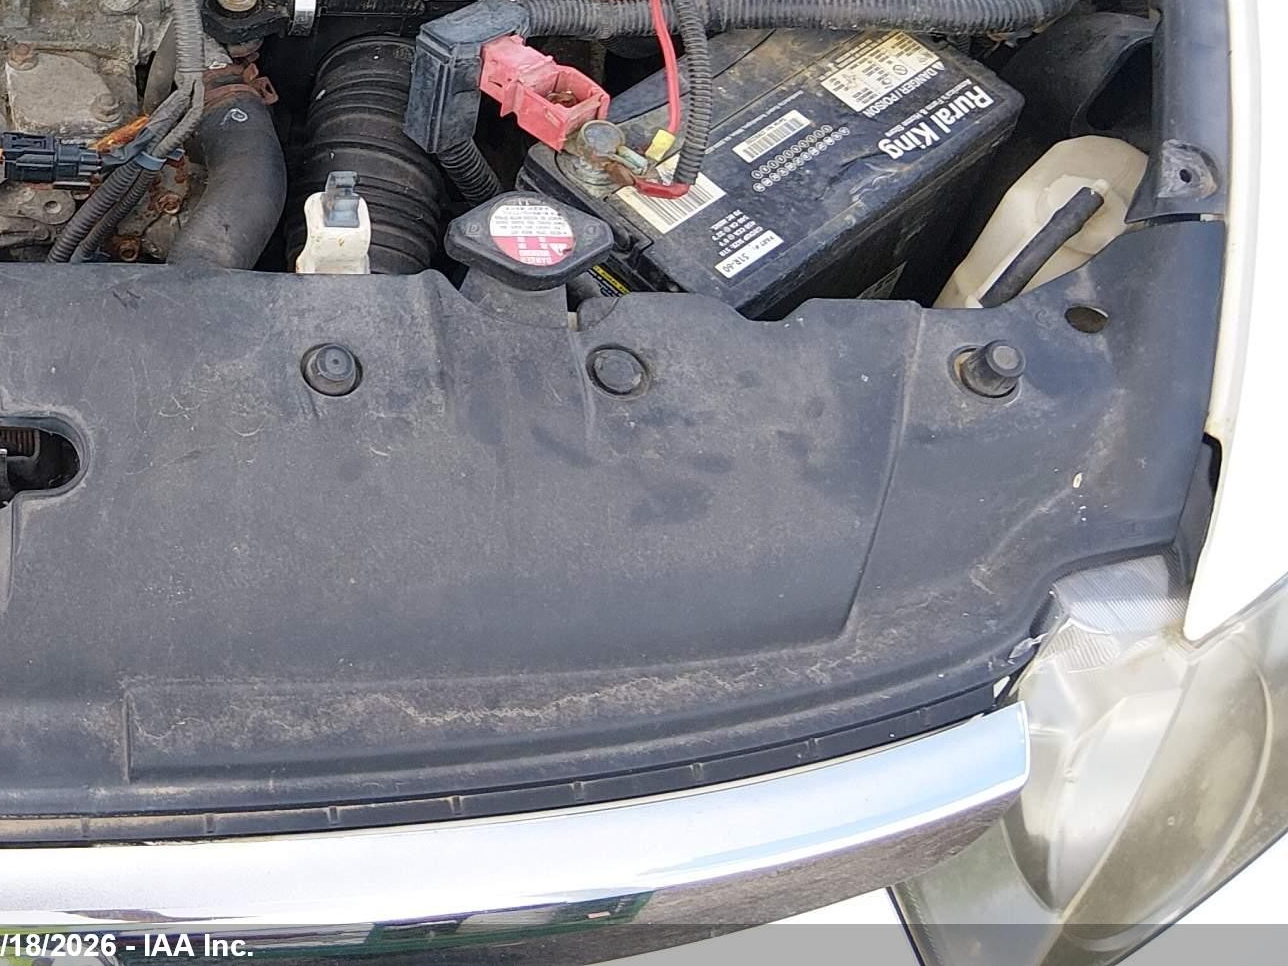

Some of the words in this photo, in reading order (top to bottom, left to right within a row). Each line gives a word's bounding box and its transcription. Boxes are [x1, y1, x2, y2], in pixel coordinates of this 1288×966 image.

[898, 68, 938, 95] DANGER
[862, 93, 898, 118] POISON
[930, 85, 994, 134] Rural
[878, 121, 940, 159] King
